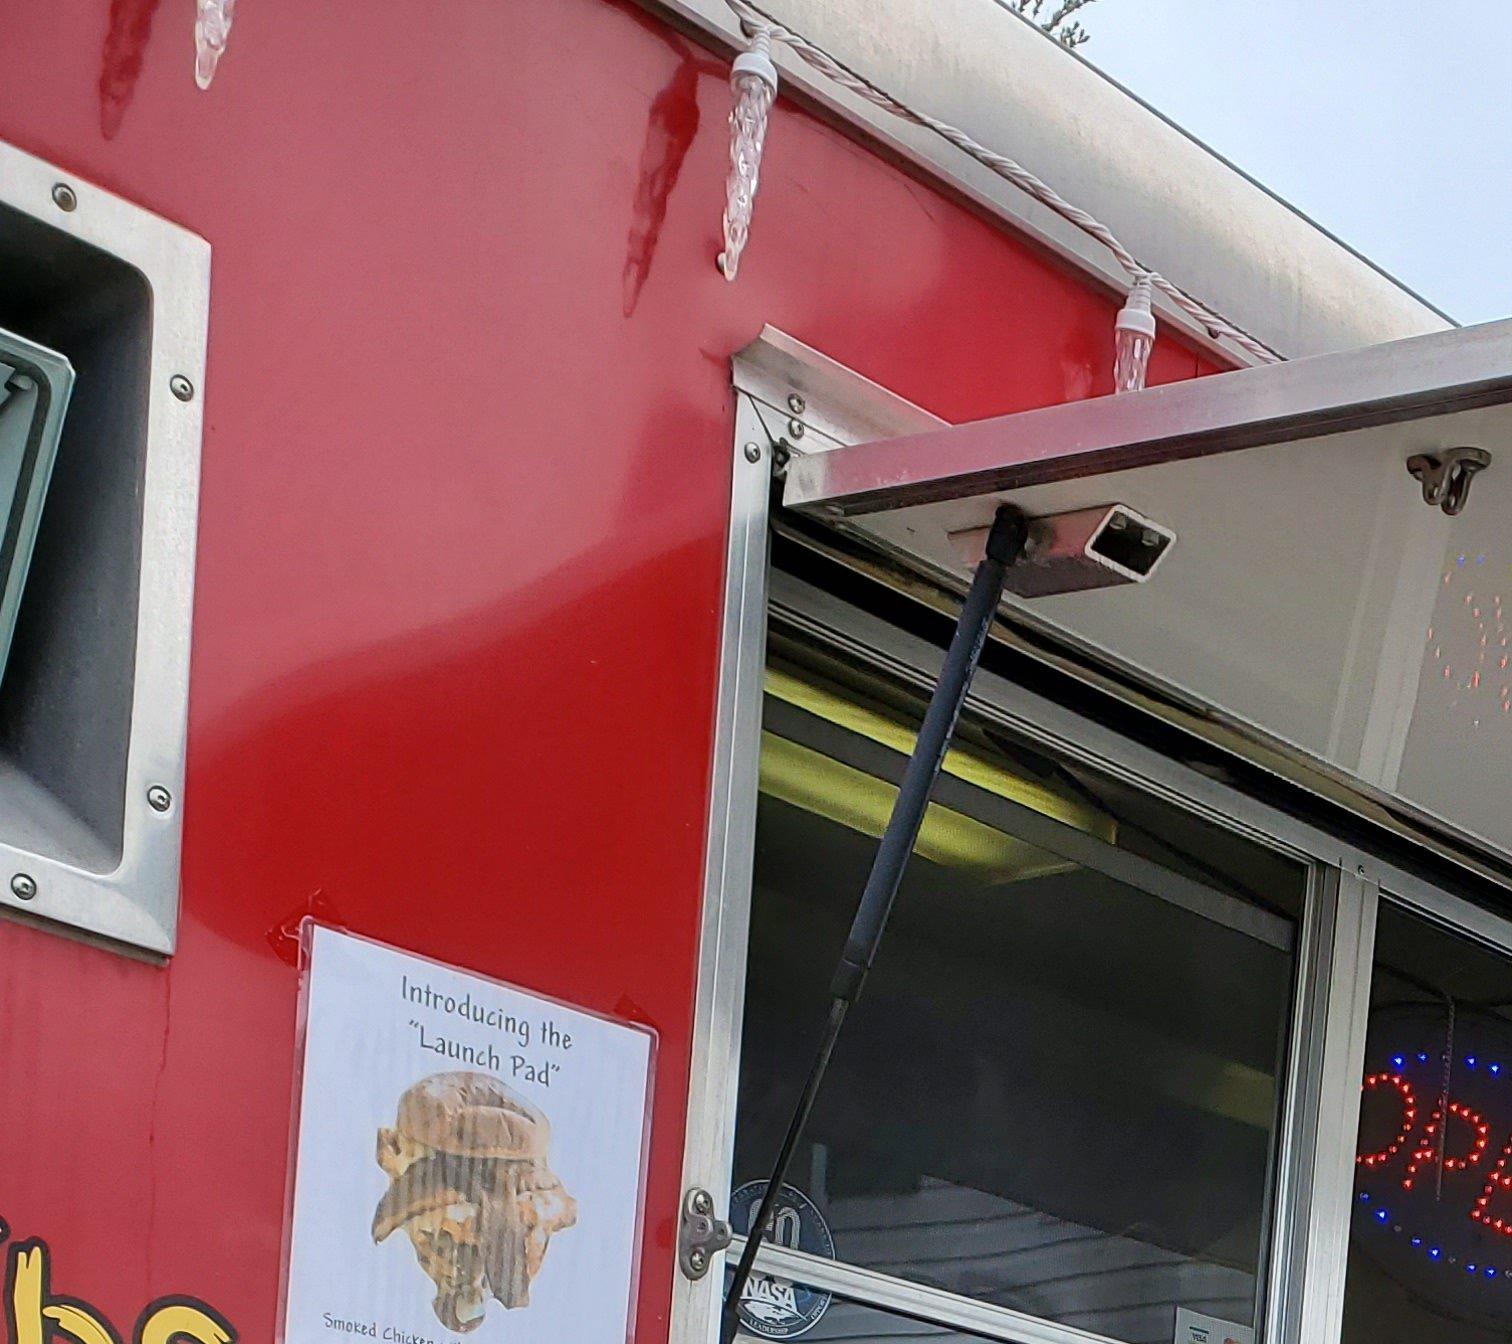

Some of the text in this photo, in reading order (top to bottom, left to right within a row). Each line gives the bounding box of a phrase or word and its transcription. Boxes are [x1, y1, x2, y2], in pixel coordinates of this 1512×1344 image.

[402, 975, 573, 1050] Introducing the
[741, 1277, 798, 1312] NASA
[322, 1312, 377, 1338] Smoked
